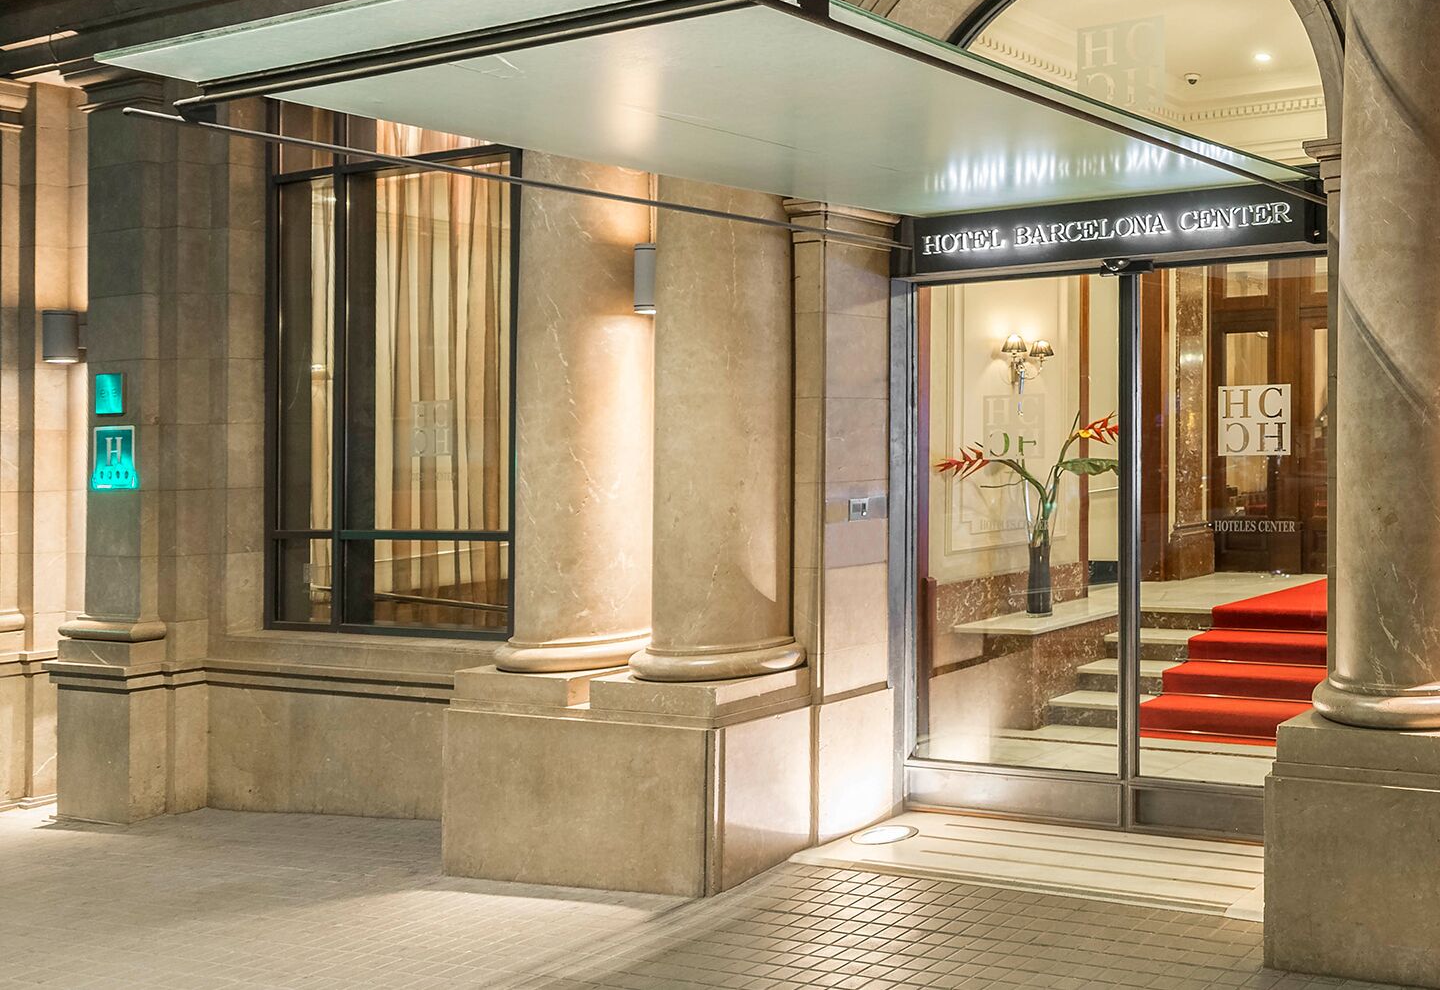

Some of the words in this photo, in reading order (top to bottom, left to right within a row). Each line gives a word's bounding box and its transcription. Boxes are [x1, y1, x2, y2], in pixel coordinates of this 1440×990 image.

[922, 229, 1006, 255] HOTEL
[1013, 213, 1171, 247] BARCELONA
[1179, 201, 1292, 232] CENTER
[105, 437, 123, 466] H
[1214, 520, 1257, 533] HOTELES
[1258, 520, 1296, 533] CENTER
